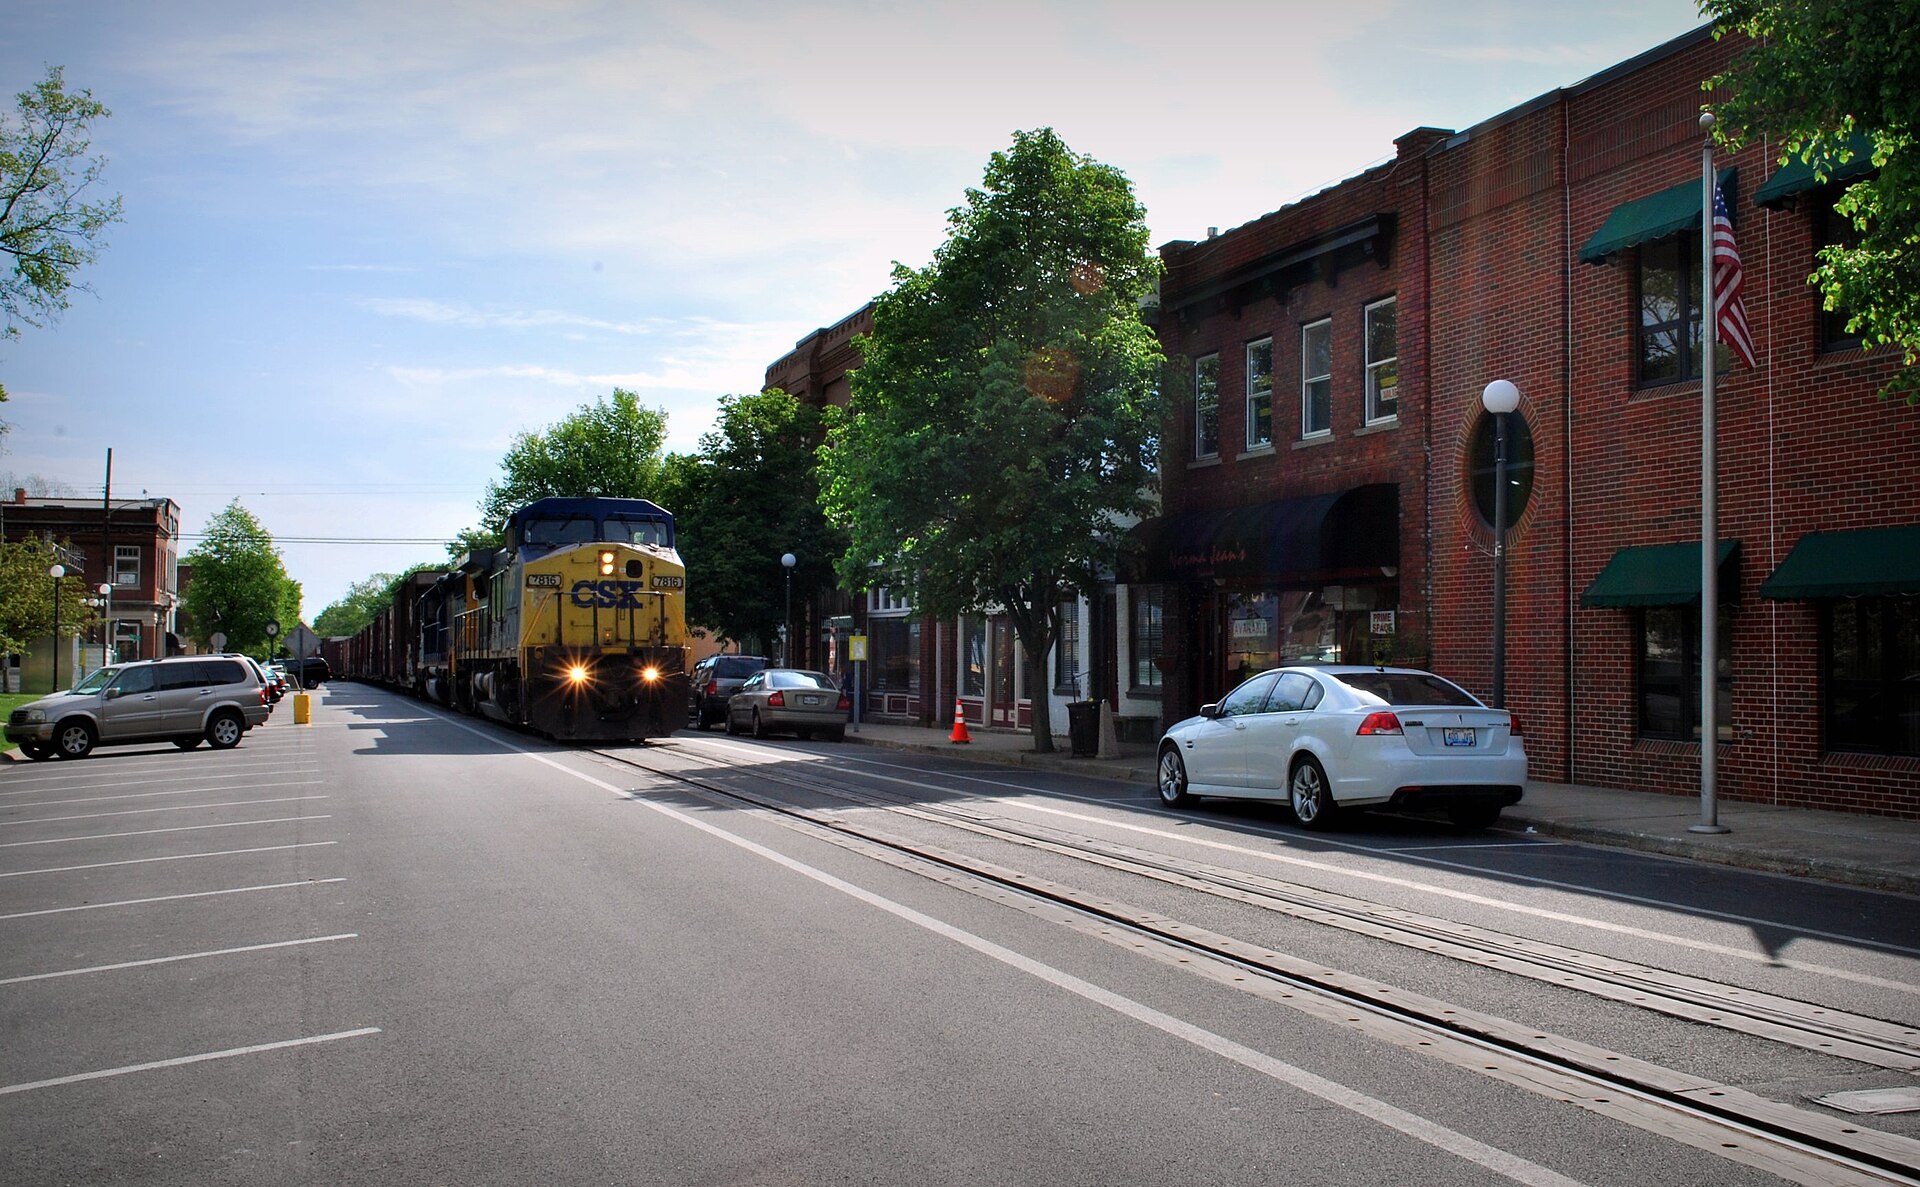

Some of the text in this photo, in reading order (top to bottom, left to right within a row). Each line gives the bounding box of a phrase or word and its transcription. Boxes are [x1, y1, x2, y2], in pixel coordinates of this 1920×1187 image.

[533, 576, 557, 587] 7816
[657, 577, 679, 587] 7816
[571, 580, 643, 608] CSX
[1373, 613, 1391, 622] PRIME
